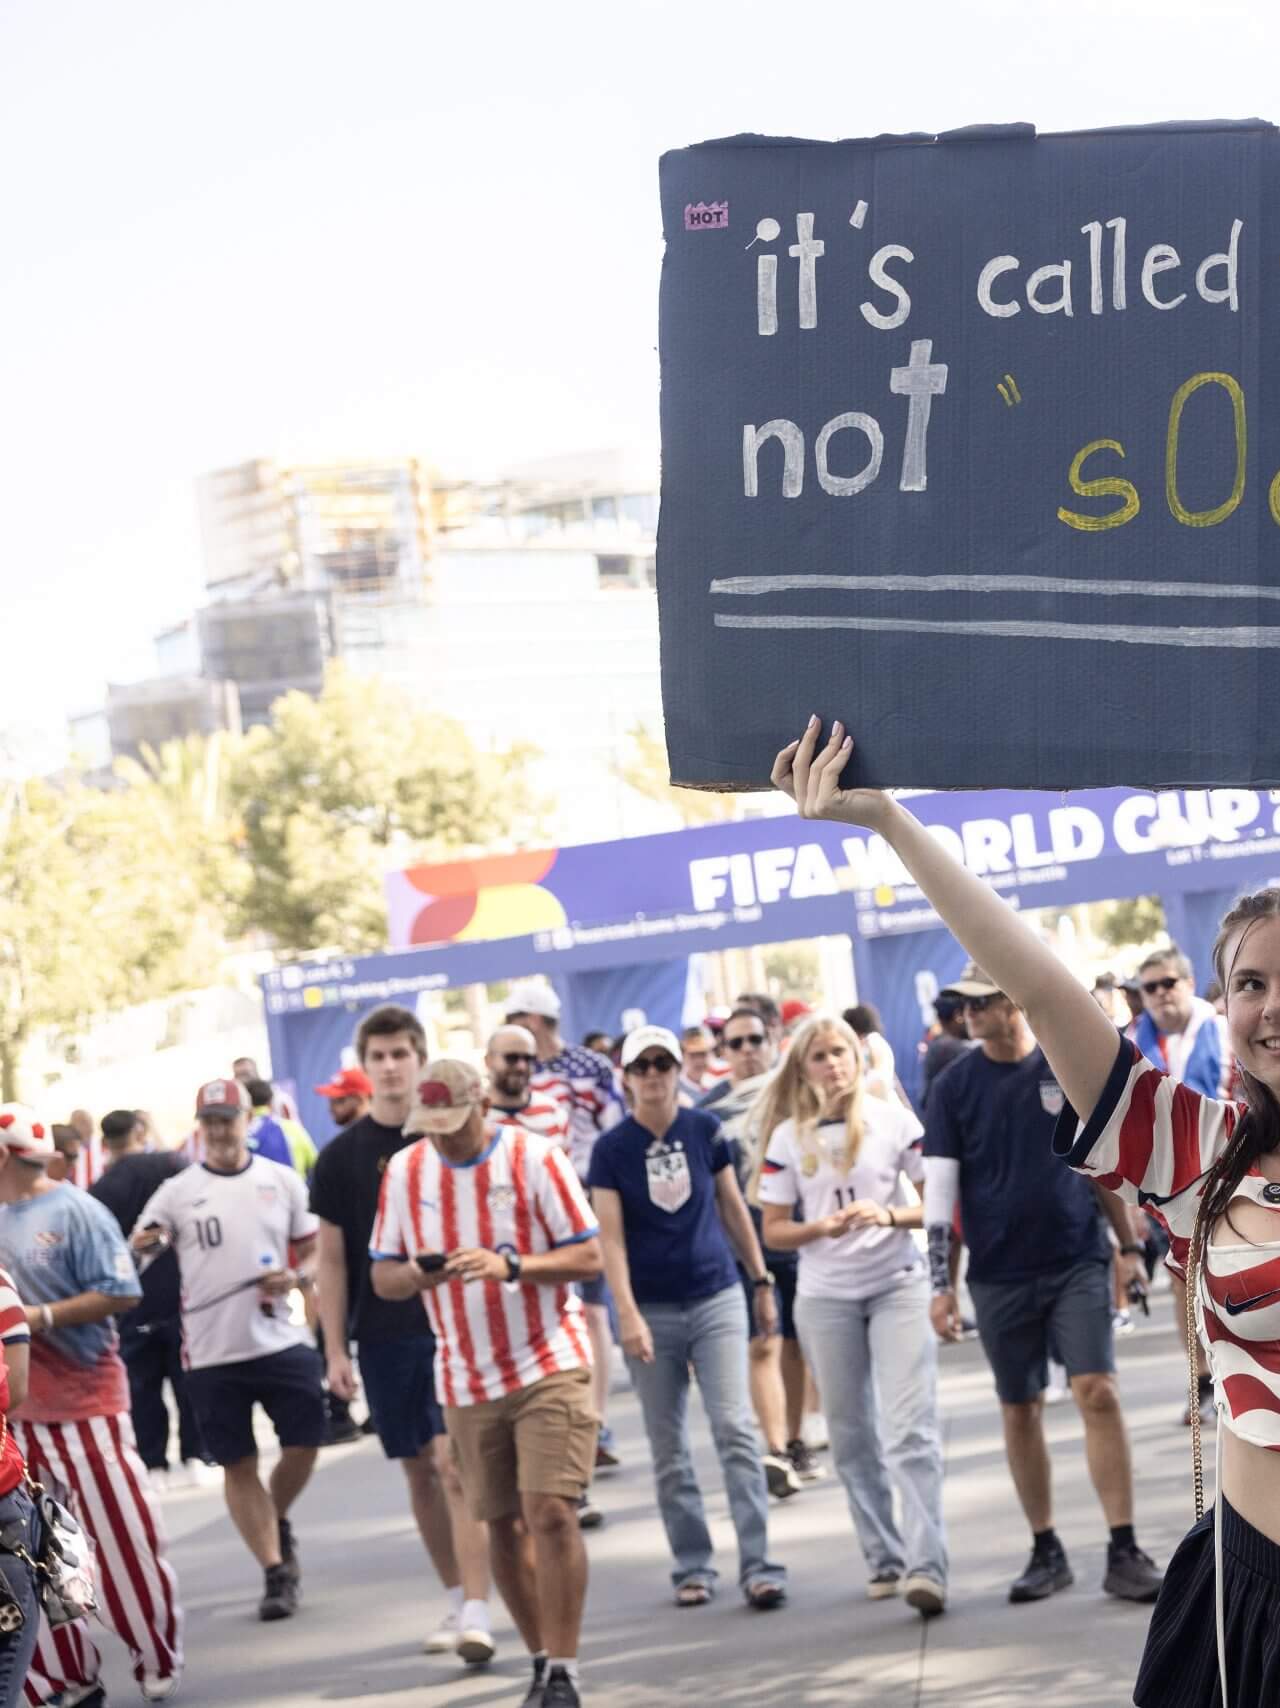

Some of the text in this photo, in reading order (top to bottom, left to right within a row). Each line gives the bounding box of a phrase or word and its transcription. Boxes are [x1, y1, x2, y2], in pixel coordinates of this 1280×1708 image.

[690, 210, 723, 225] HOT
[747, 199, 915, 336] it's
[976, 216, 1244, 318] called
[742, 338, 948, 499] not
[688, 842, 840, 912] FIFA
[195, 1215, 223, 1250] 10
